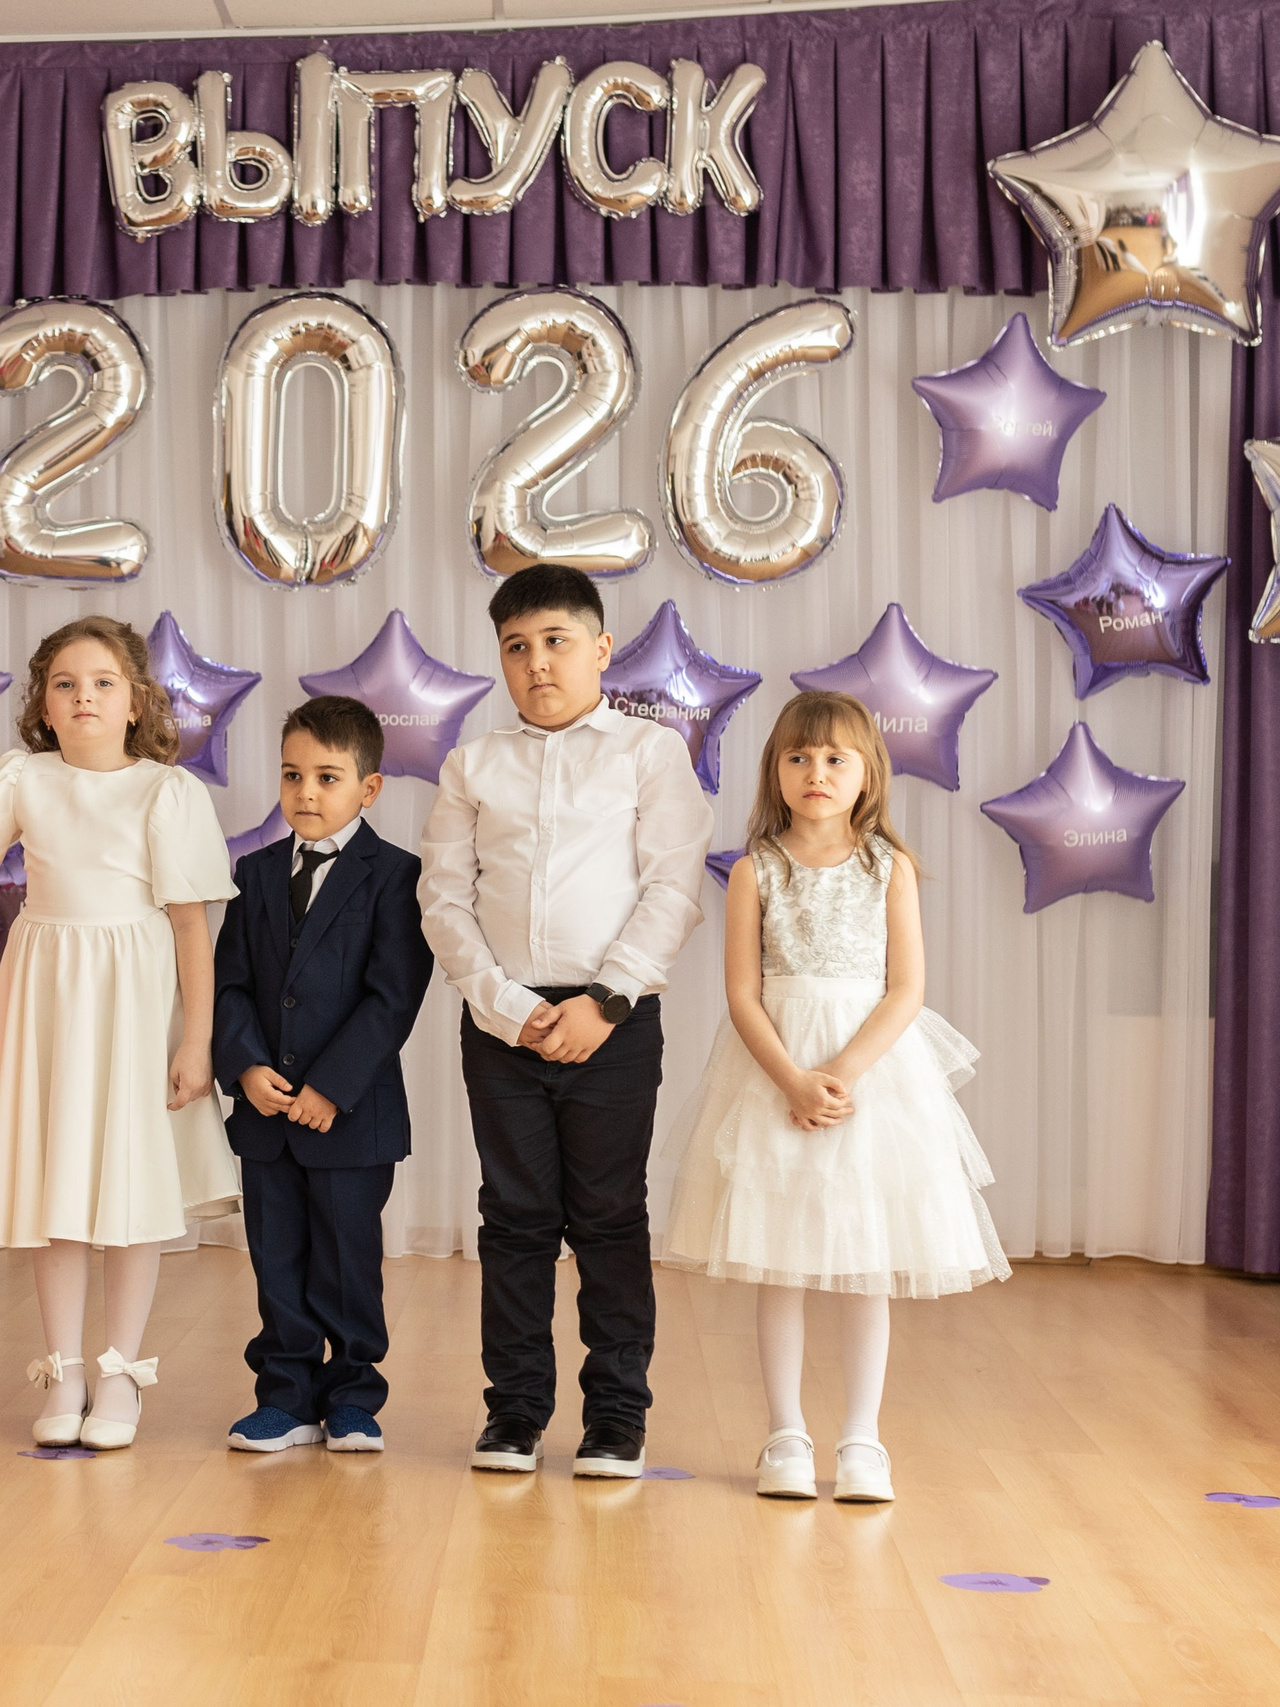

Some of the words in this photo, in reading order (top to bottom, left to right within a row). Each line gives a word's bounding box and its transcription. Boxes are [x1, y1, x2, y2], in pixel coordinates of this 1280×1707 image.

[103, 52, 767, 240] ВЫПУСК
[1099, 611, 1163, 634] Роман
[614, 696, 711, 721] Стефания
[163, 714, 212, 730] елина
[375, 713, 440, 727] рослав
[1063, 828, 1127, 848] Элина
